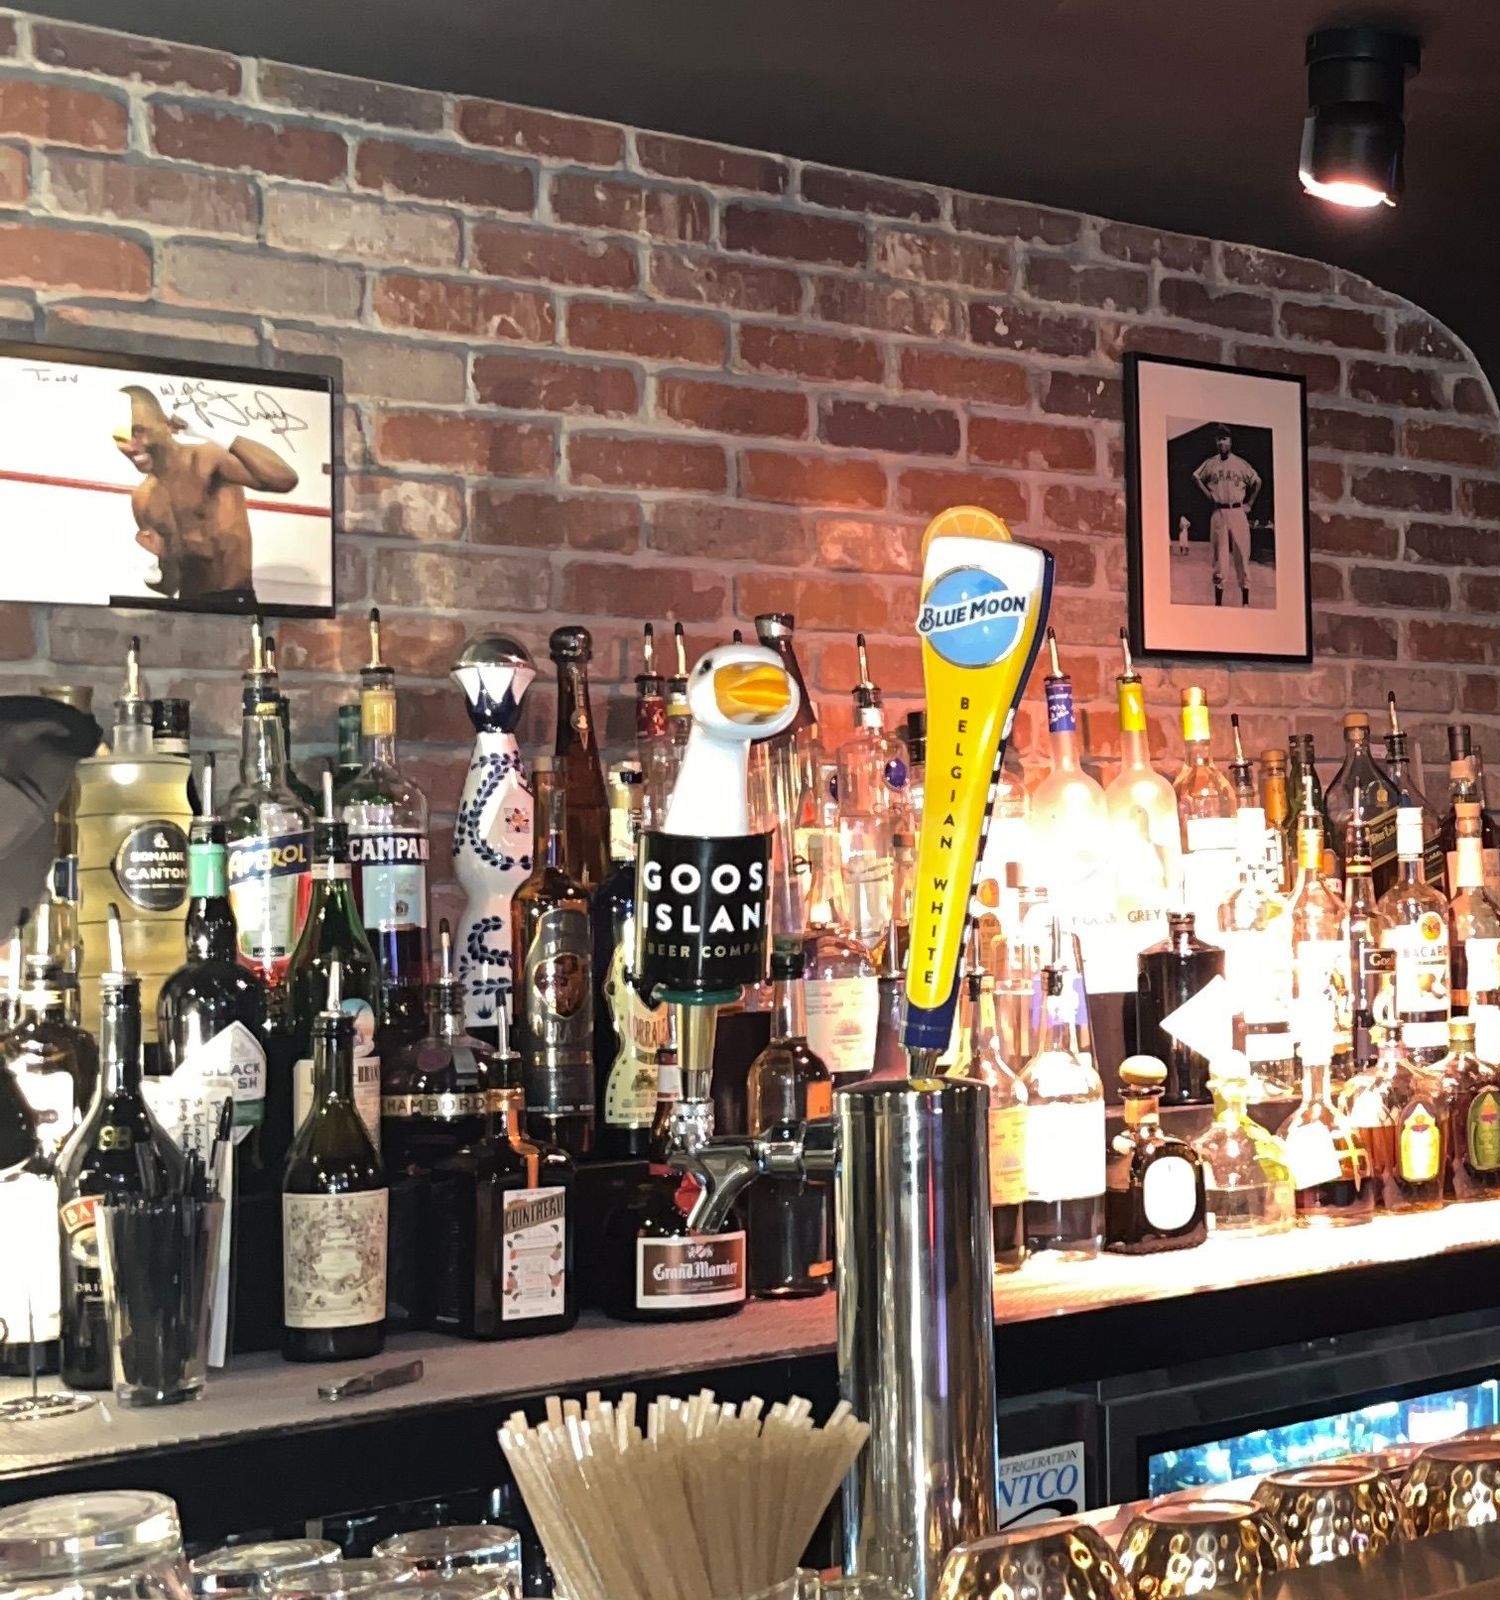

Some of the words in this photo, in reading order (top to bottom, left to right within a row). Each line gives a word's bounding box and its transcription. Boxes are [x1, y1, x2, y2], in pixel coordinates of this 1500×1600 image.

[919, 605, 968, 632] BLUE
[969, 596, 1026, 620] MOON
[940, 697, 970, 849] BELGIAN
[228, 843, 307, 880] APEROL
[643, 860, 764, 895] GOOS
[643, 901, 761, 933] ISLAN
[923, 877, 949, 984] WHITE
[504, 1192, 565, 1232] COINTREAU
[1000, 1449, 1079, 1476] EFRIGERATION
[999, 1464, 1079, 1508] NTCO
